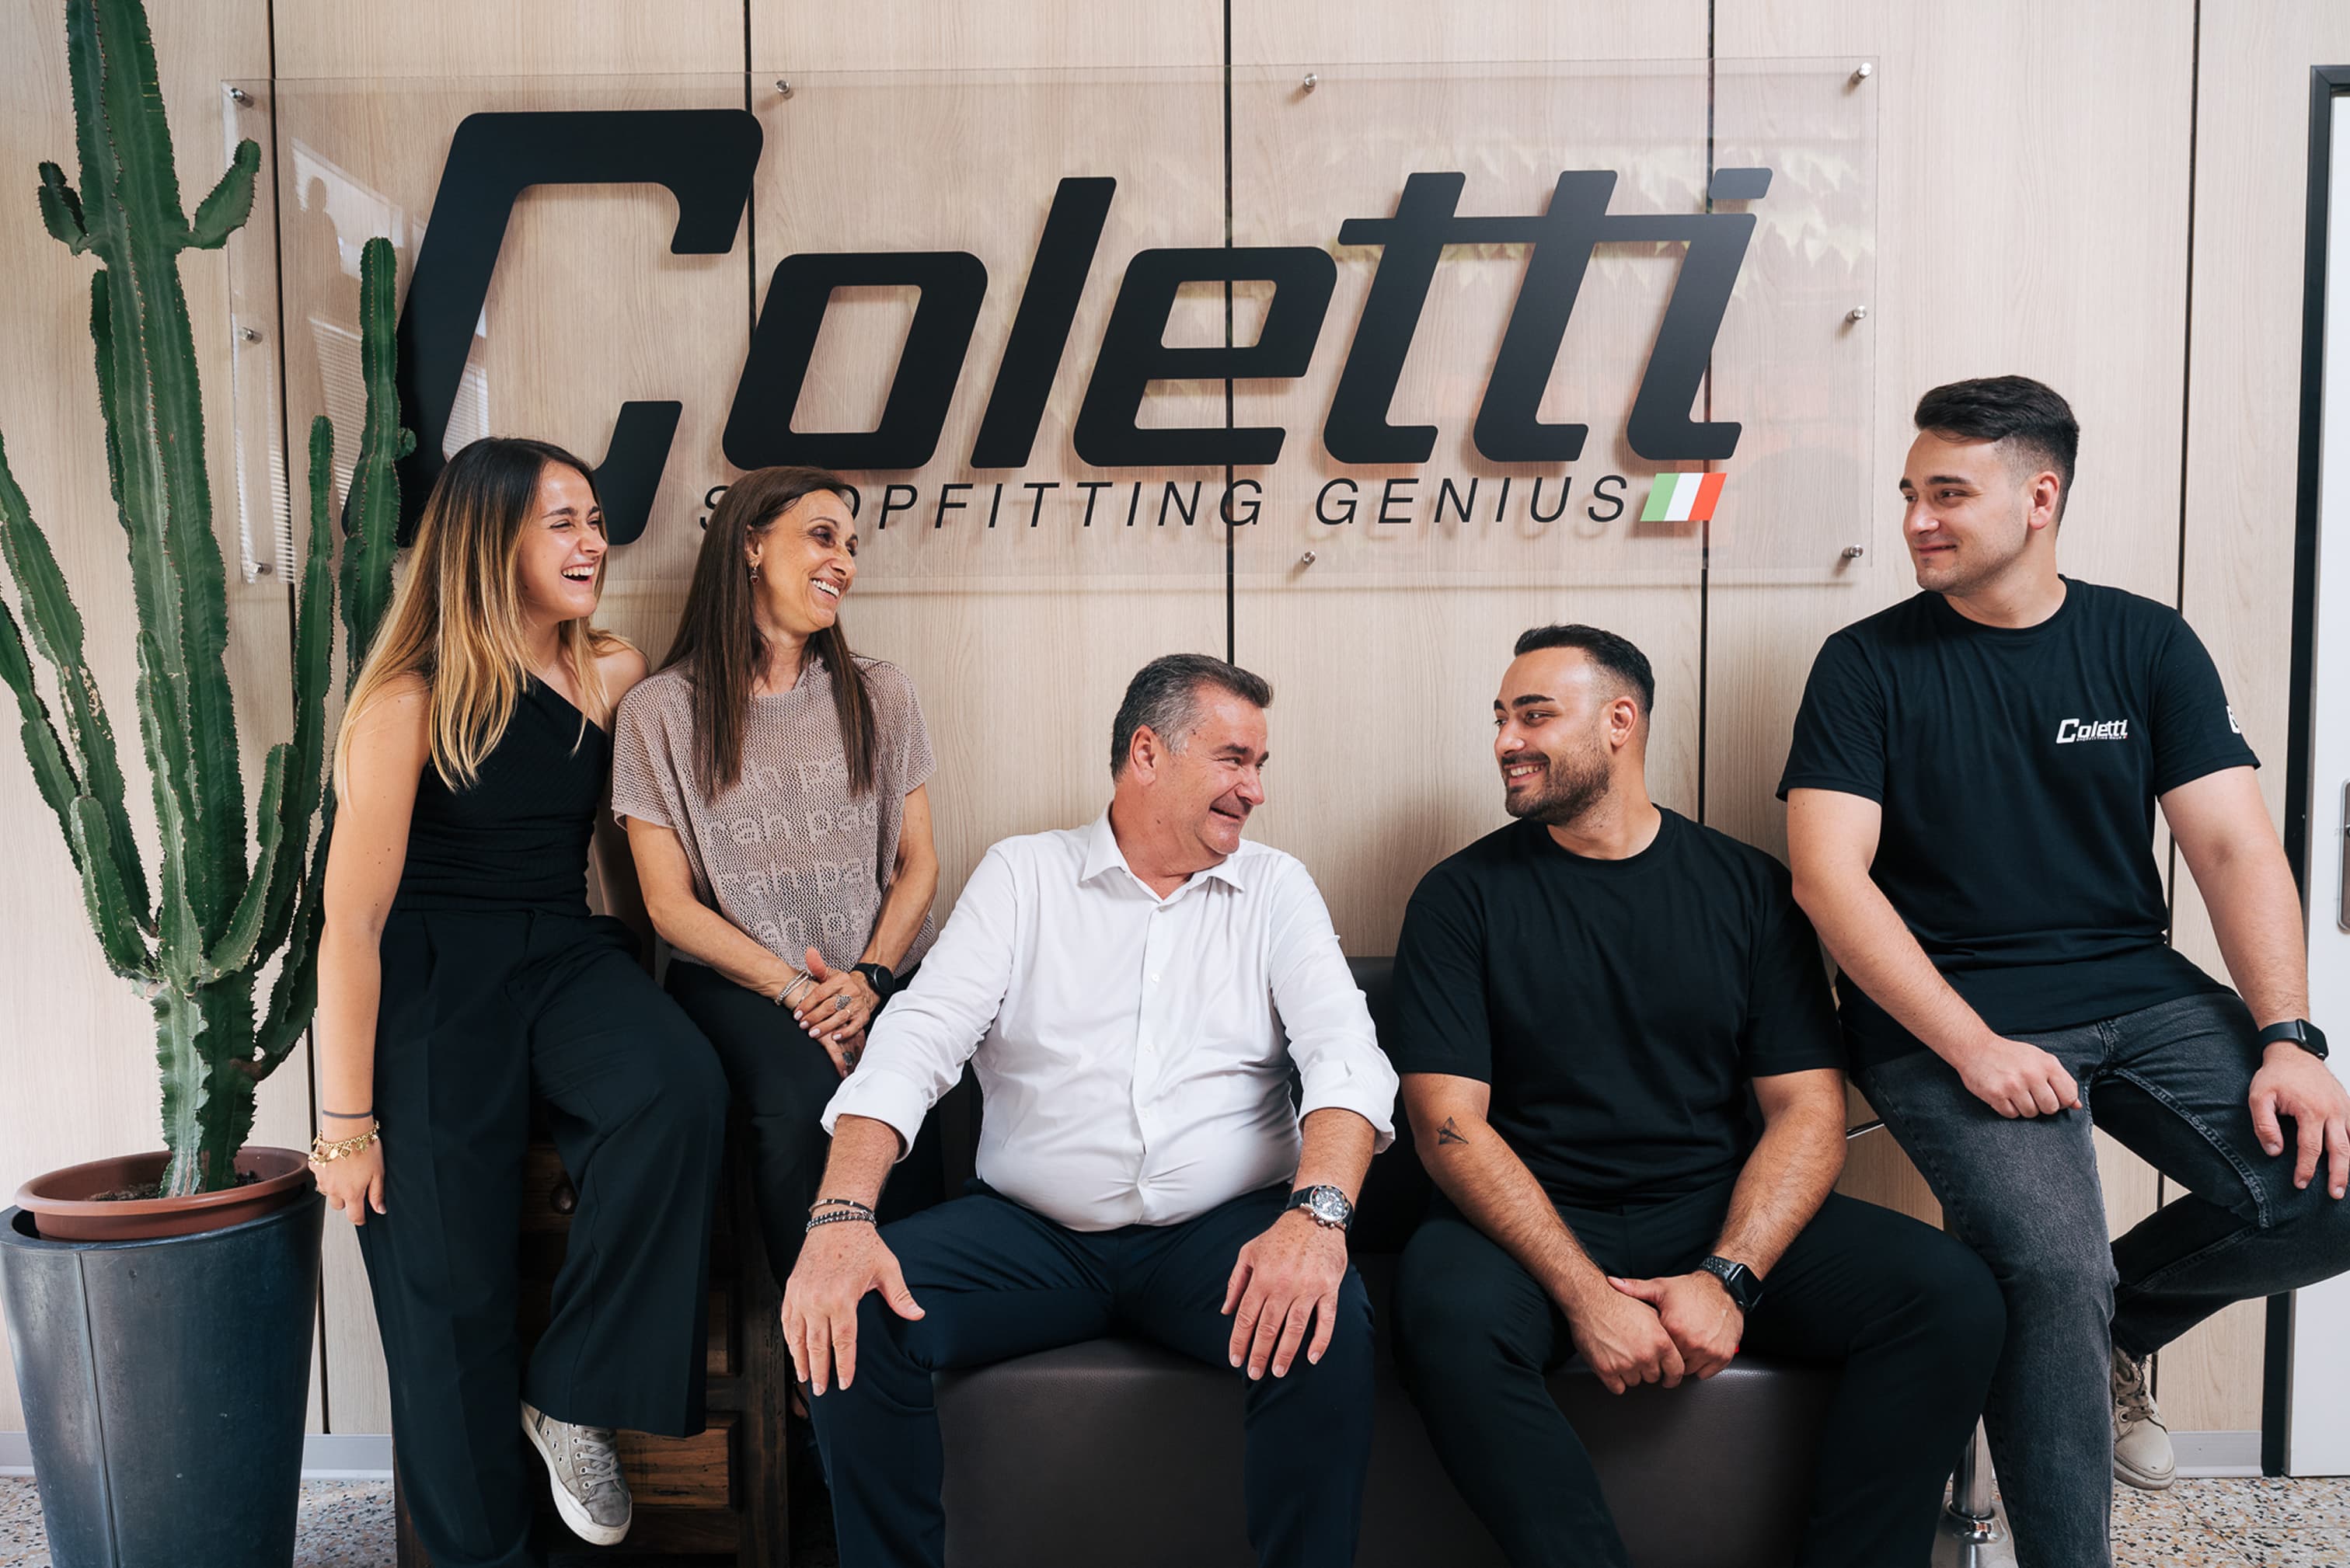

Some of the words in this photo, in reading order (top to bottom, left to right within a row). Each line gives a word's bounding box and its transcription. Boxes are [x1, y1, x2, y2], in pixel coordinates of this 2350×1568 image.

[342, 108, 1773, 547] Coletti
[700, 479, 1262, 531] PFITTING
[1315, 475, 1627, 525] GENIUS
[2055, 719, 2129, 744] Coletti
